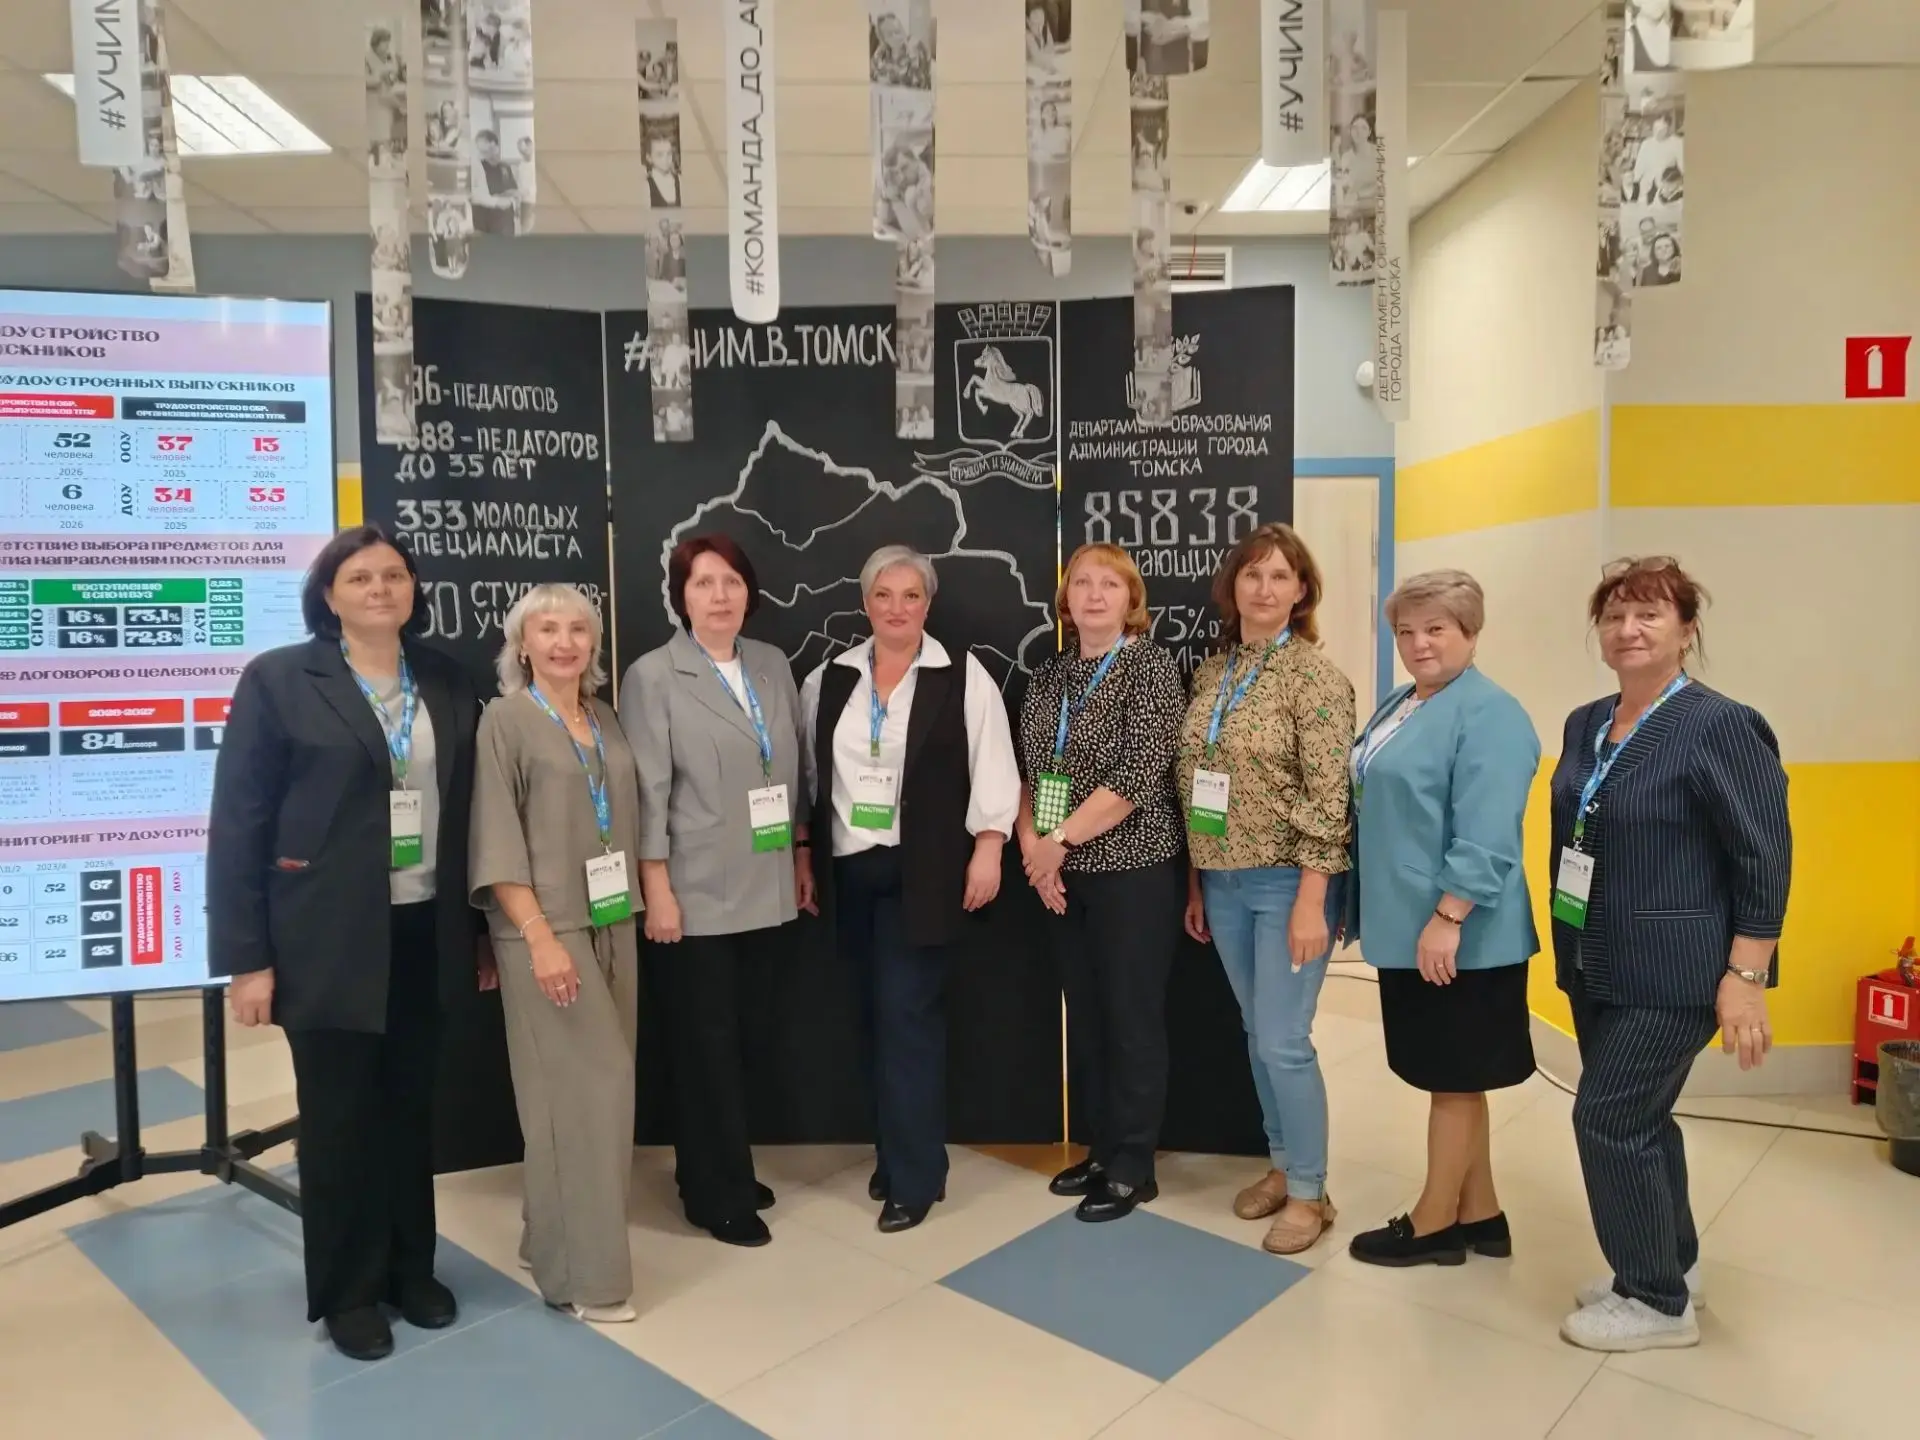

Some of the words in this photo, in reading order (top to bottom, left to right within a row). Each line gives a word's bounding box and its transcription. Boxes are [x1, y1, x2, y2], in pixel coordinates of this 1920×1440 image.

[739, 0, 765, 296] #КОМАНДА_ДО_А
[1389, 257, 1402, 328] ТОМСКА
[1377, 276, 1389, 402] ДЕПАРТАМЕНТ
[1390, 333, 1402, 402] ГОРОДА
[168, 379, 296, 393] ВЫПУСКНИКОВ
[1171, 414, 1273, 434] ОБРАЗОВАНИЯ
[54, 432, 91, 449] 52
[157, 436, 193, 451] 37
[252, 437, 280, 452] 13
[477, 426, 599, 461] ПЕДАГОГОВ
[1069, 437, 1198, 461] АДМИНИСТРАЦИИ
[1208, 437, 1269, 457] ГОРОДА
[394, 453, 436, 483] ДО
[448, 453, 485, 478] 35
[493, 457, 536, 481] ЛЕТ
[1130, 457, 1203, 477] ТОМСКА
[62, 484, 82, 500] 6
[154, 487, 192, 503] 34
[395, 499, 467, 532] 353
[472, 500, 579, 533] МОЛОДЫХ
[252, 541, 284, 551] ДЛЯ
[396, 530, 583, 559] СПЕЦИАЛИСТА
[1148, 605, 1205, 641] 75%
[18, 669, 120, 681] ДОГОВОРОВ
[123, 668, 135, 678] О
[81, 732, 123, 749] 84
[856, 806, 890, 815] УЧАСТНИК
[44, 883, 66, 894] 52
[89, 879, 114, 891] 67
[45, 914, 68, 925] 58
[45, 949, 66, 959] 22
